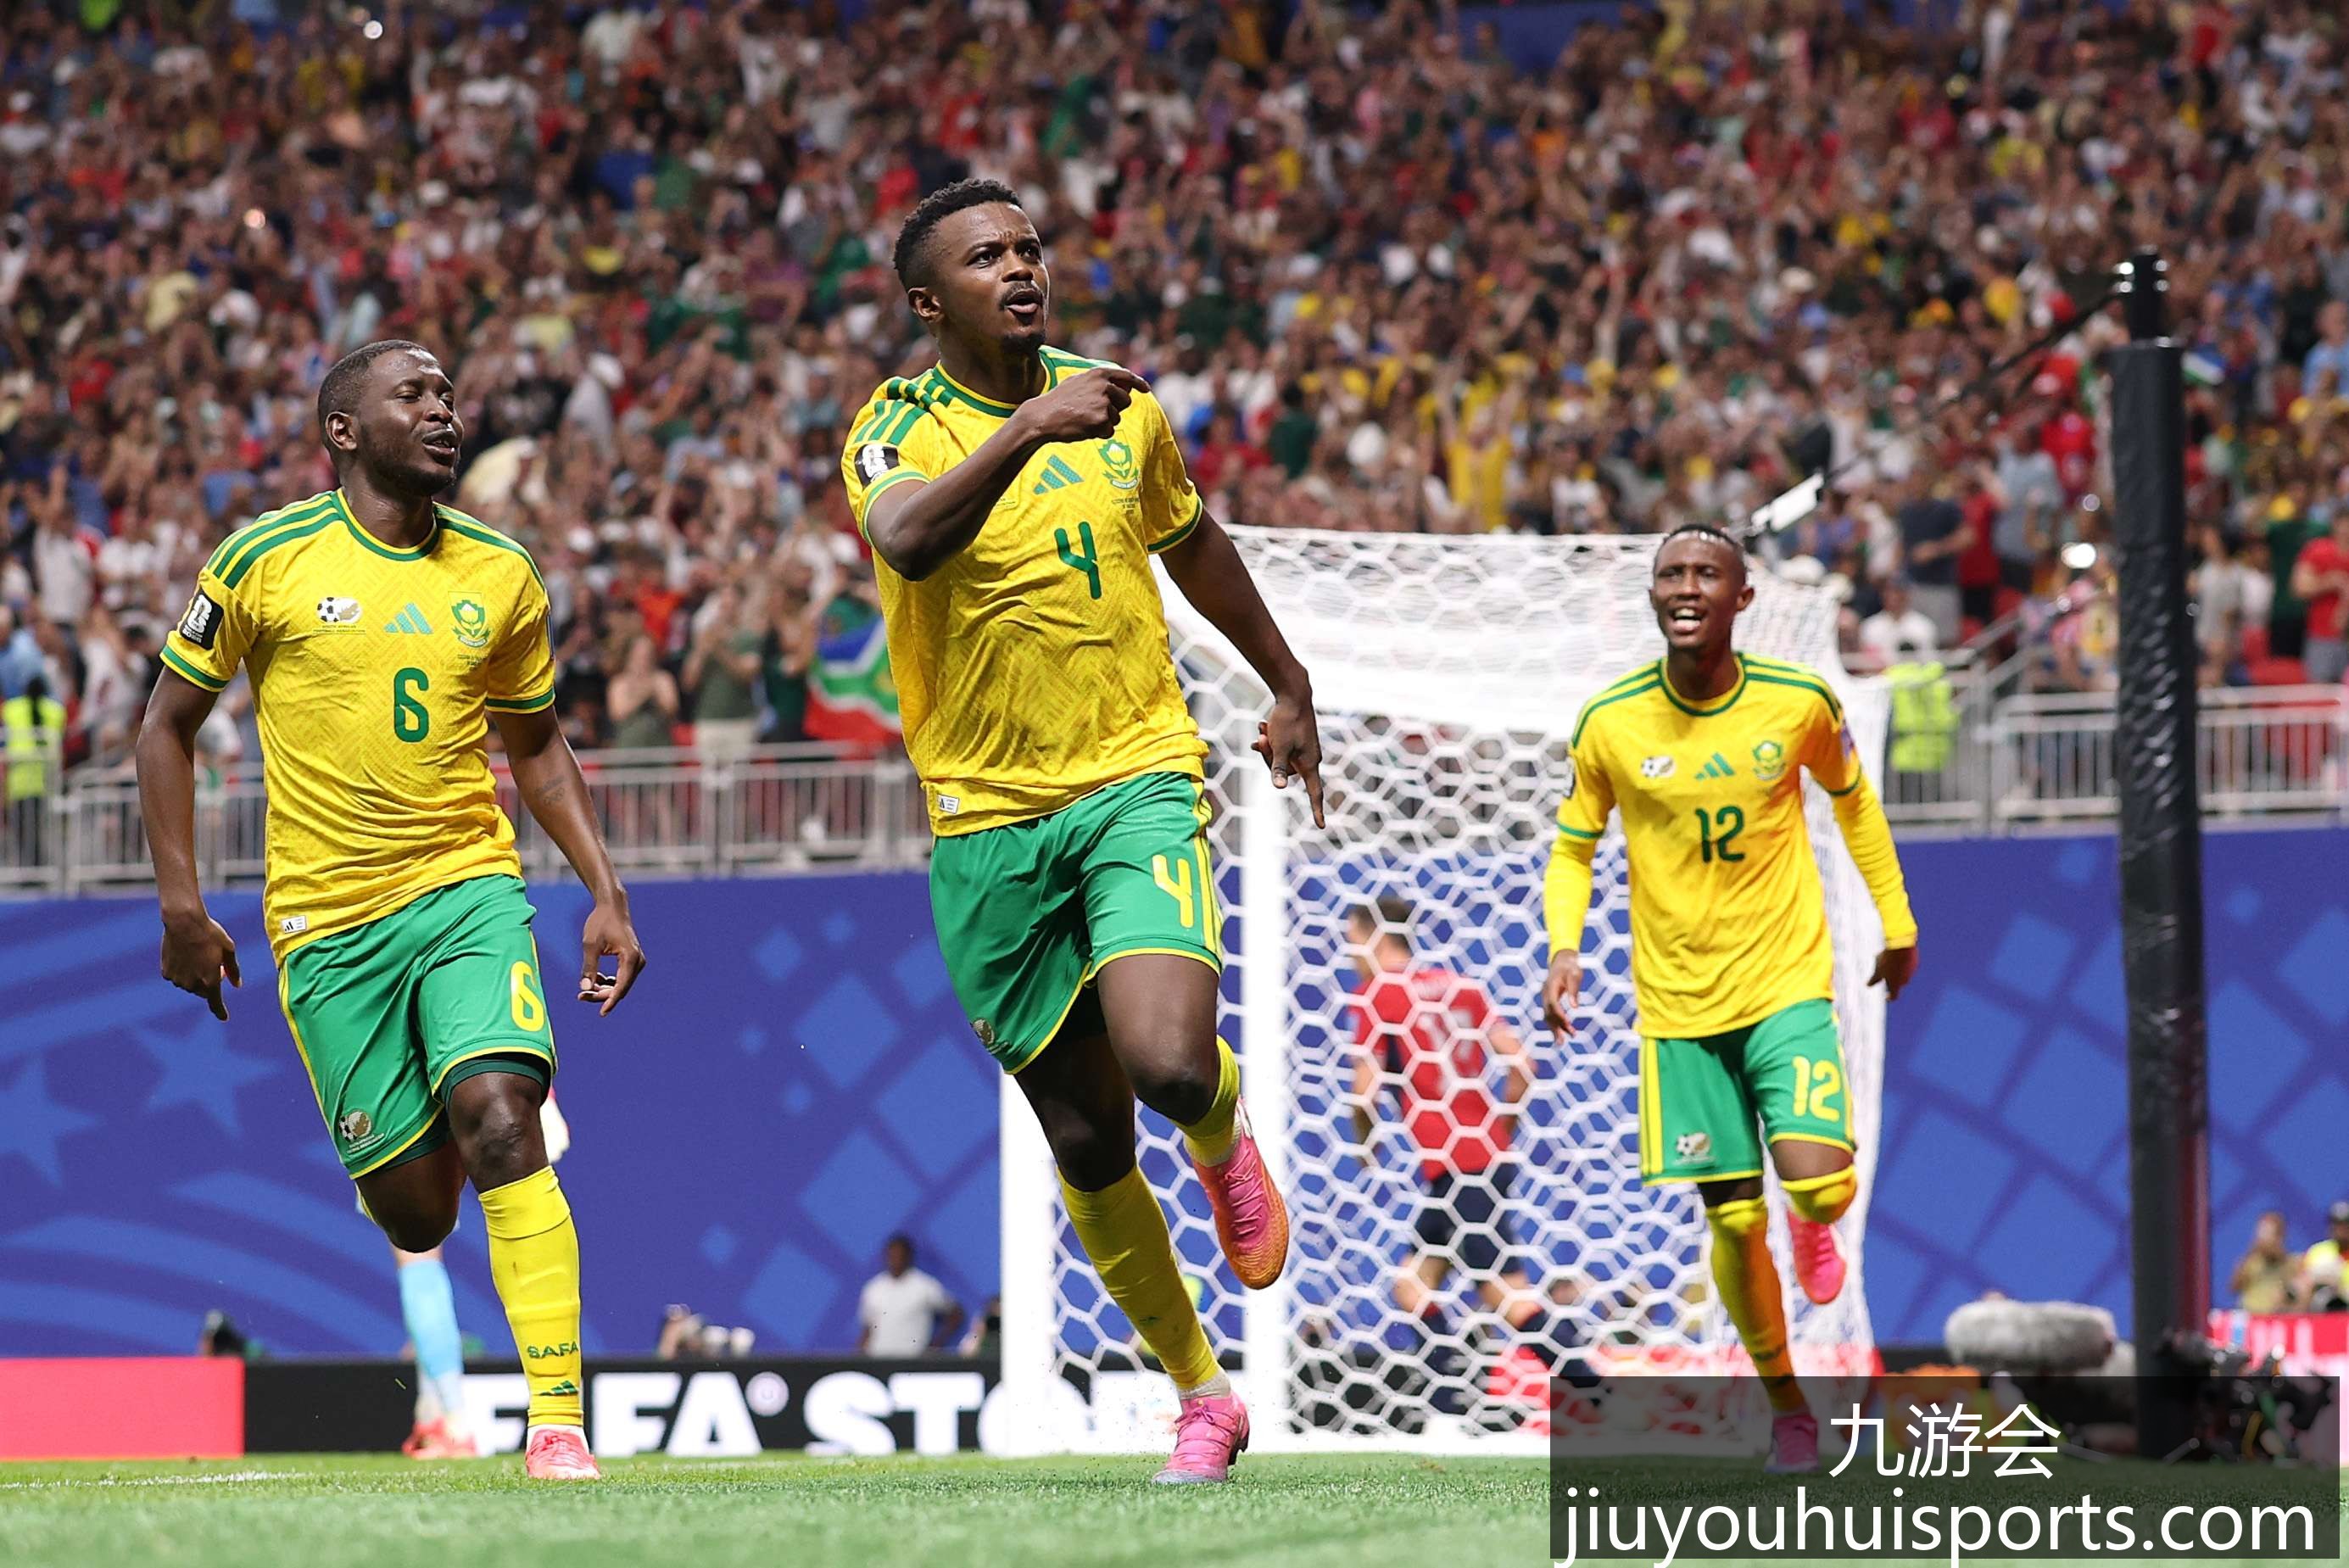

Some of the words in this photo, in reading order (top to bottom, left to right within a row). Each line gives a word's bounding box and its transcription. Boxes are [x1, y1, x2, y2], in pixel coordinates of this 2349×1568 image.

[1055, 521, 1102, 600] 4
[393, 667, 430, 743] 6
[1695, 805, 1746, 864] 12
[1152, 853, 1195, 929] 4
[511, 960, 544, 1032] 6
[1792, 1055, 1841, 1123] 12
[527, 1341, 579, 1359] SAFA
